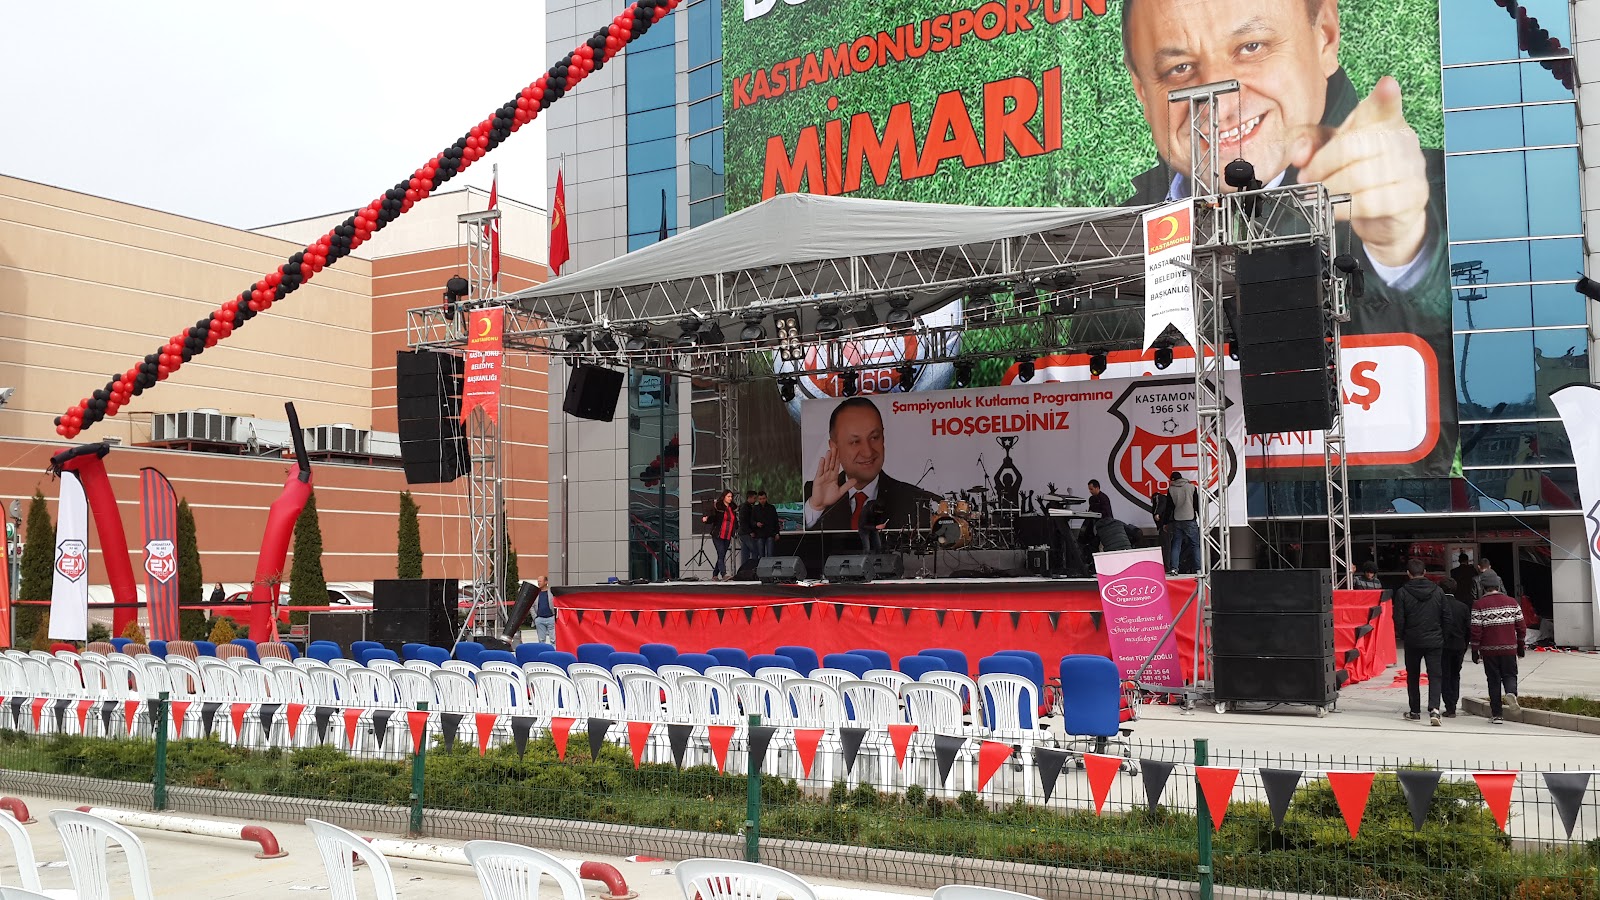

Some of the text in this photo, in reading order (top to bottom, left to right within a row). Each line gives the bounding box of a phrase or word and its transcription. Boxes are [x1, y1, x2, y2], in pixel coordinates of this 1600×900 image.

[761, 65, 1063, 201] MİMARI
[1150, 236, 1189, 252] KASTAMONU
[1154, 268, 1187, 285] BELEDİYE
[471, 362, 494, 370] BELEDİYE
[467, 374, 497, 383] BAŞKANLIĞI
[830, 367, 893, 397] 166
[892, 390, 1114, 415] Şampiyonluk Kutlama Programına
[1135, 391, 1197, 404] KASTAMON
[1150, 403, 1190, 414] 1966 SK
[931, 408, 1070, 437] HOŞGELDİNİZ
[1107, 584, 1157, 597] Beste
